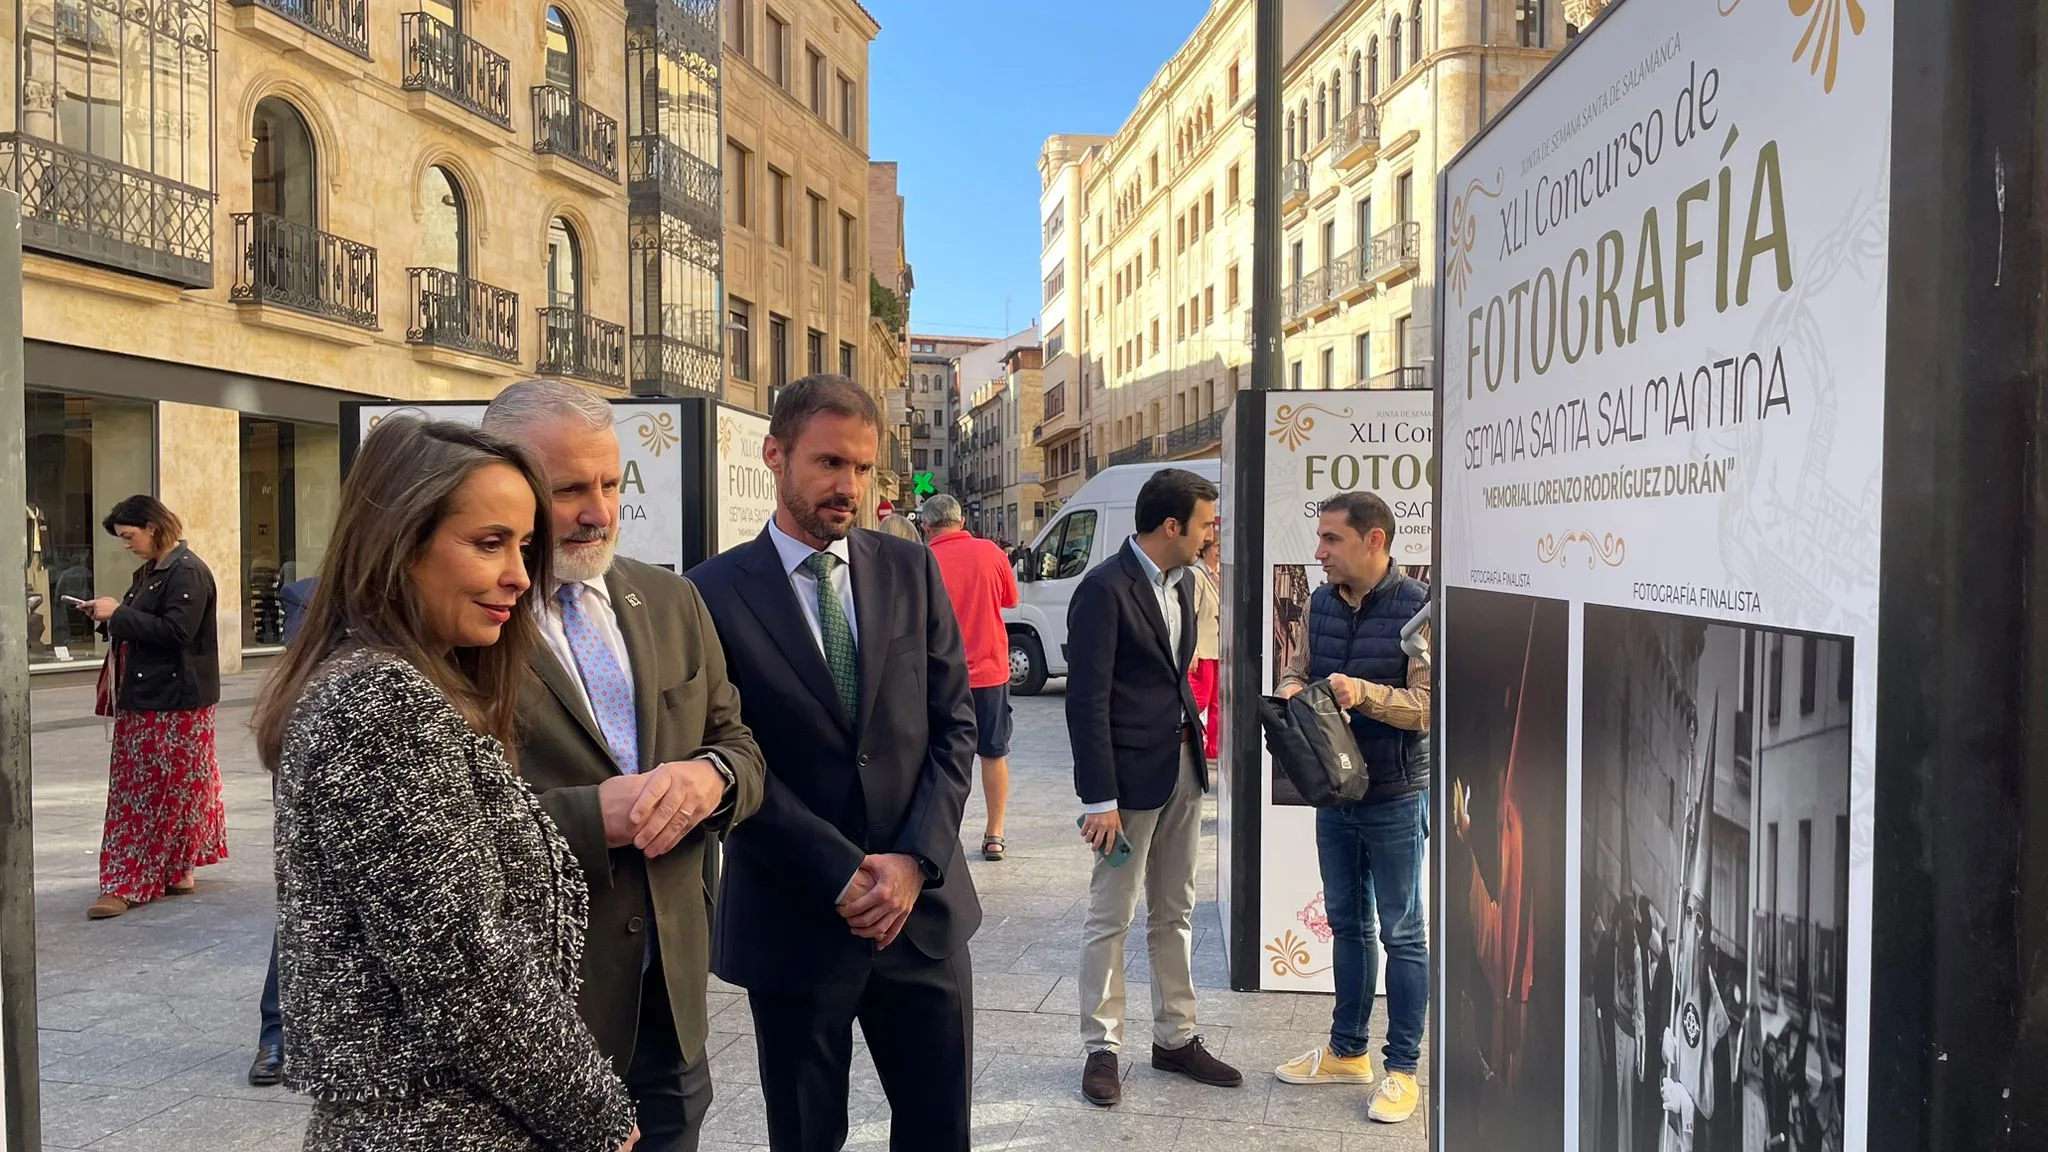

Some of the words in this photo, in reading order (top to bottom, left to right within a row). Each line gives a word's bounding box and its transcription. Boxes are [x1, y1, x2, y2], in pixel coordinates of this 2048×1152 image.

[1520, 146, 1541, 177] JUNTA
[1541, 139, 1551, 161] DE
[1551, 114, 1581, 152] SEMANA
[1582, 92, 1608, 128] SANTA
[1609, 79, 1621, 105] DE
[1622, 32, 1681, 96] SALAMANCA
[1499, 188, 1528, 262] XLI
[1535, 108, 1664, 237] Concurso
[1674, 60, 1720, 148] de
[1467, 123, 1794, 401] FOTOGRAFÍA
[1376, 410, 1399, 418] JUNTA
[1400, 410, 1410, 418] DE
[1411, 410, 1433, 418] SEMA
[1465, 415, 1526, 471] SEMANA
[1530, 398, 1591, 458] SANTA
[1597, 345, 1791, 447] SALMANTINA
[740, 438, 752, 458] XLI
[1350, 422, 1386, 443] XLI
[1305, 454, 1433, 491] FOTO
[1533, 475, 1582, 507] LORENZO
[1584, 465, 1661, 502] RODRÍGUEZ
[1503, 571, 1531, 589] FINALISTA
[1633, 581, 1697, 607] FOTOGRAFÍA
[1700, 587, 1761, 613] FINALISTA
